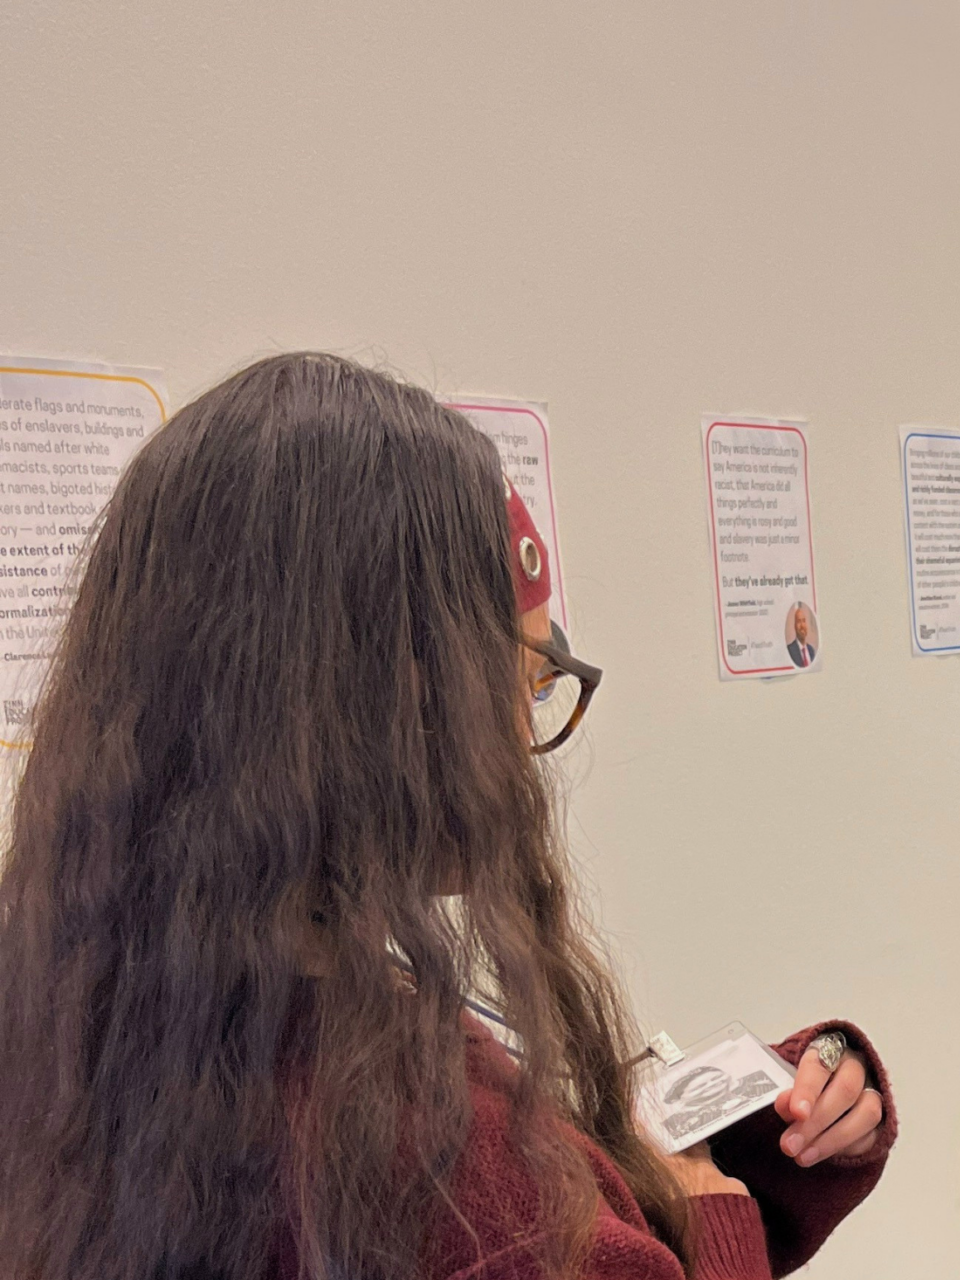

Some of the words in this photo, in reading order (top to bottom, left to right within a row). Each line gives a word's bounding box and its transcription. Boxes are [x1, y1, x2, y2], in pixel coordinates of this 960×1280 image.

[35, 397, 63, 415] flags
[66, 400, 86, 414] and
[87, 403, 145, 419] monuments,
[10, 418, 22, 431] of
[25, 419, 84, 435] enslavers,
[84, 421, 125, 439] buildings
[126, 425, 145, 438] and
[13, 439, 52, 453] named
[54, 440, 82, 454] after
[84, 441, 110, 456] white
[522, 455, 539, 466] raw
[52, 463, 89, 477] sports
[520, 473, 536, 486] the
[7, 483, 49, 496] names,
[50, 481, 94, 498] bigoted
[24, 501, 45, 515] and
[36, 522, 57, 535] and
[9, 545, 50, 557] extent
[52, 543, 64, 556] of
[50, 563, 61, 577] of
